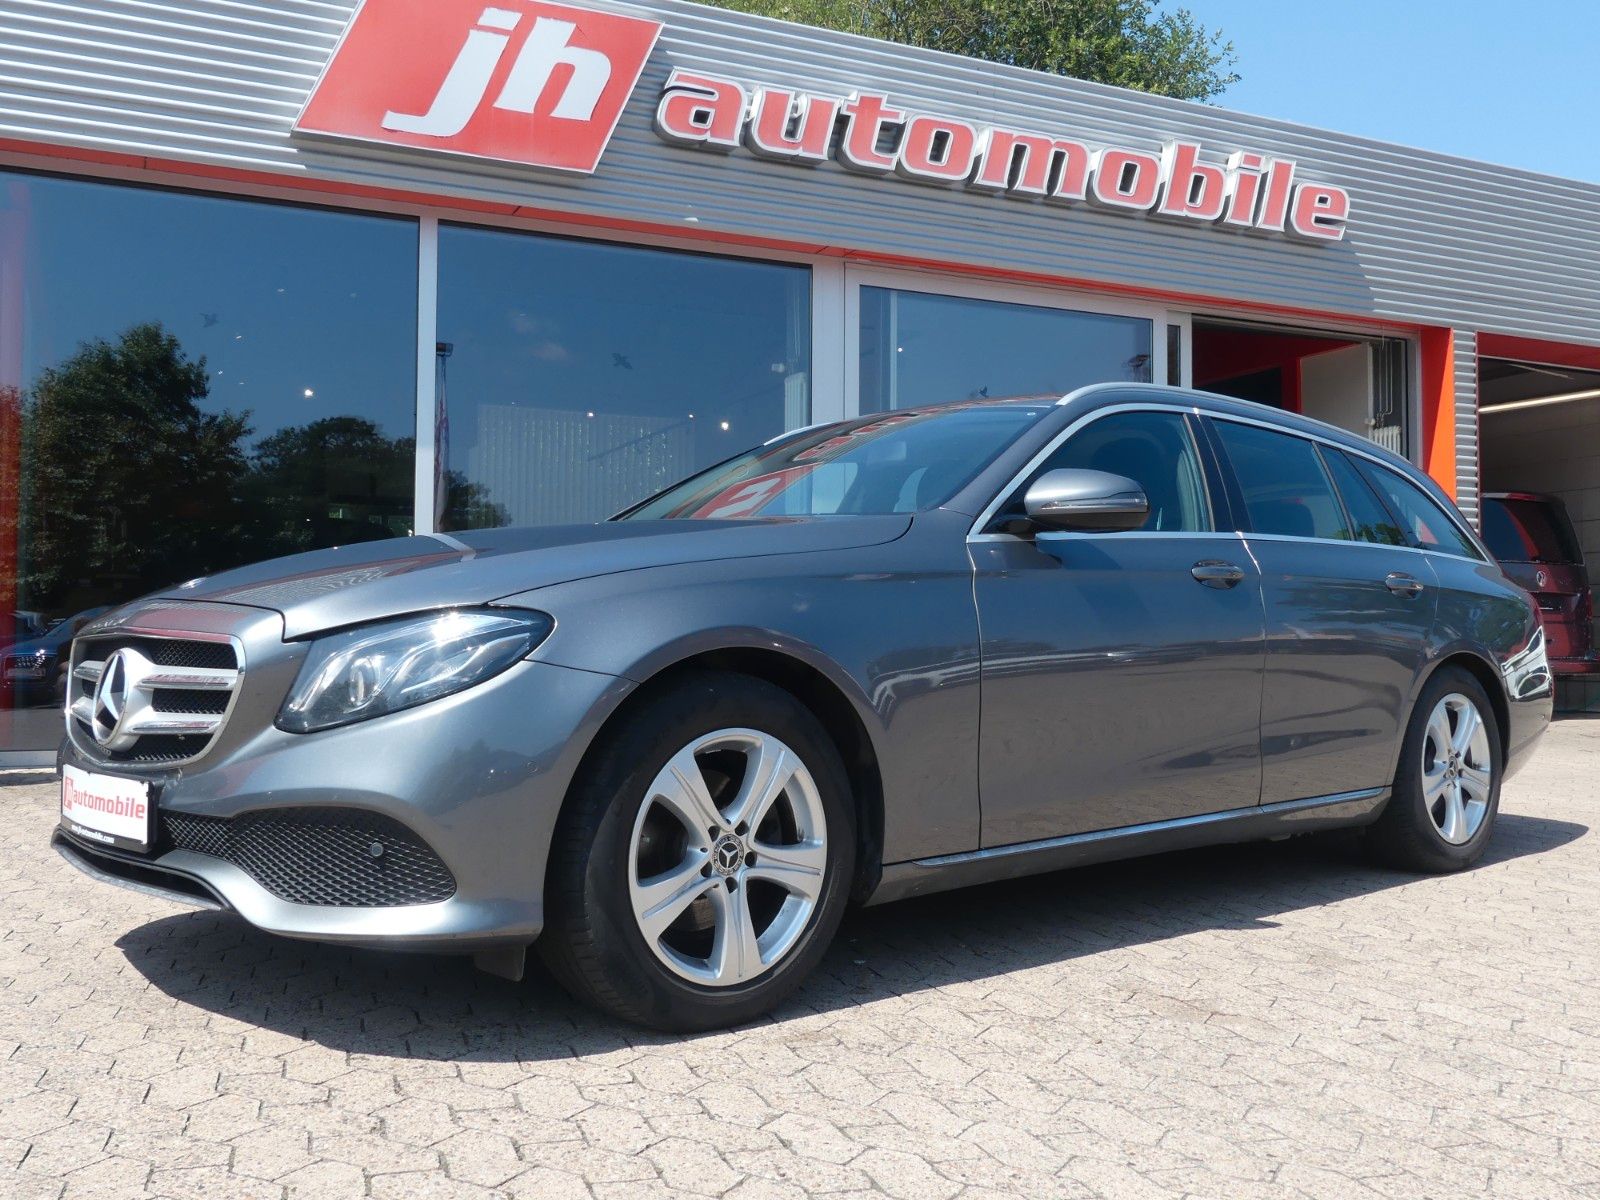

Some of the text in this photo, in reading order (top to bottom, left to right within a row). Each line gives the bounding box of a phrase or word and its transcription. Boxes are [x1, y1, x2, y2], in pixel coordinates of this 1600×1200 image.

[381, 7, 612, 138] jh
[656, 66, 1350, 241] automobile
[73, 789, 145, 819] automobile
